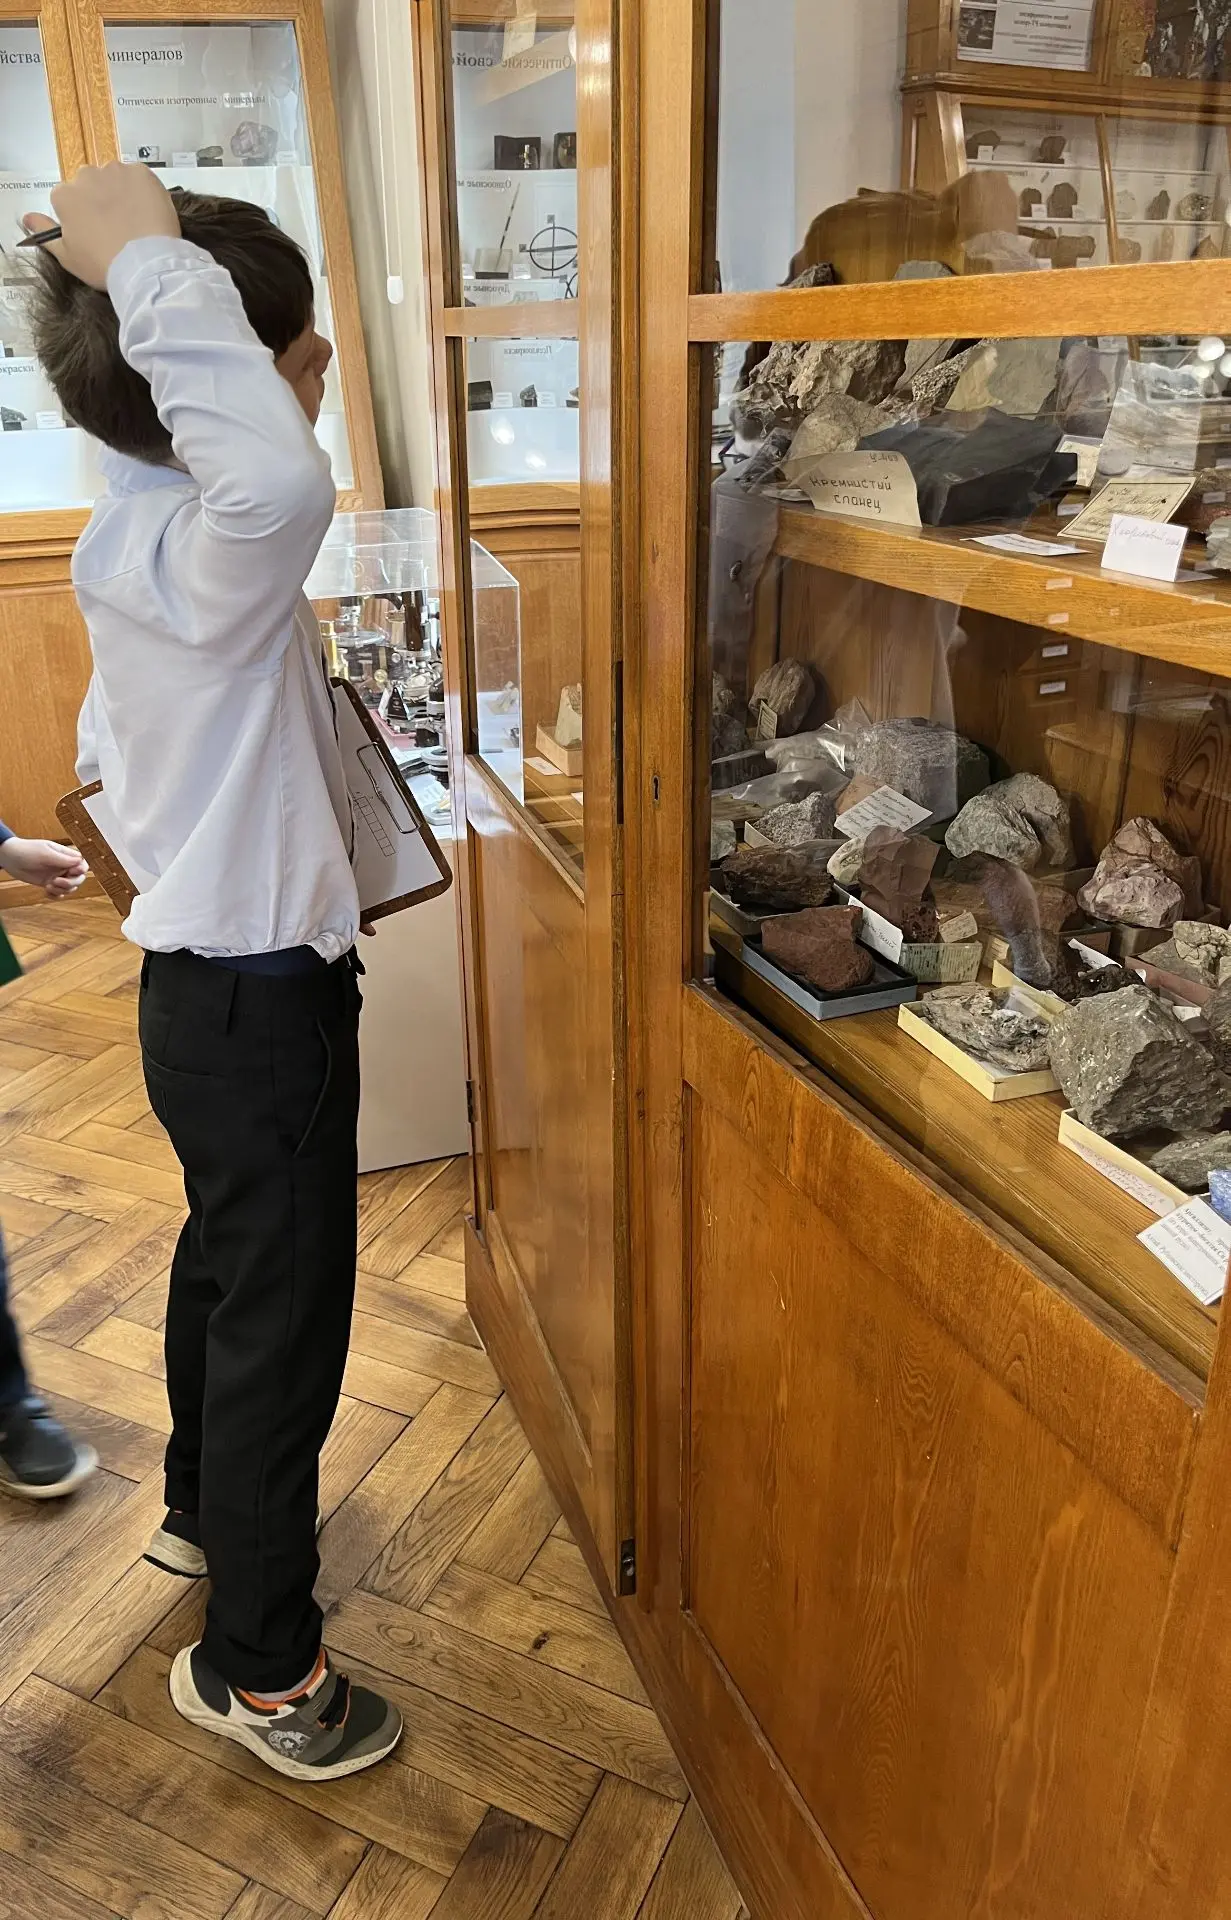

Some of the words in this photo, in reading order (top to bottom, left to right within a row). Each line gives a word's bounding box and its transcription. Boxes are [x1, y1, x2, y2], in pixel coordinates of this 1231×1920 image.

[117, 96, 164, 106] Оптически
[809, 475, 892, 491] Кремнистый
[833, 494, 882, 514] сланец
